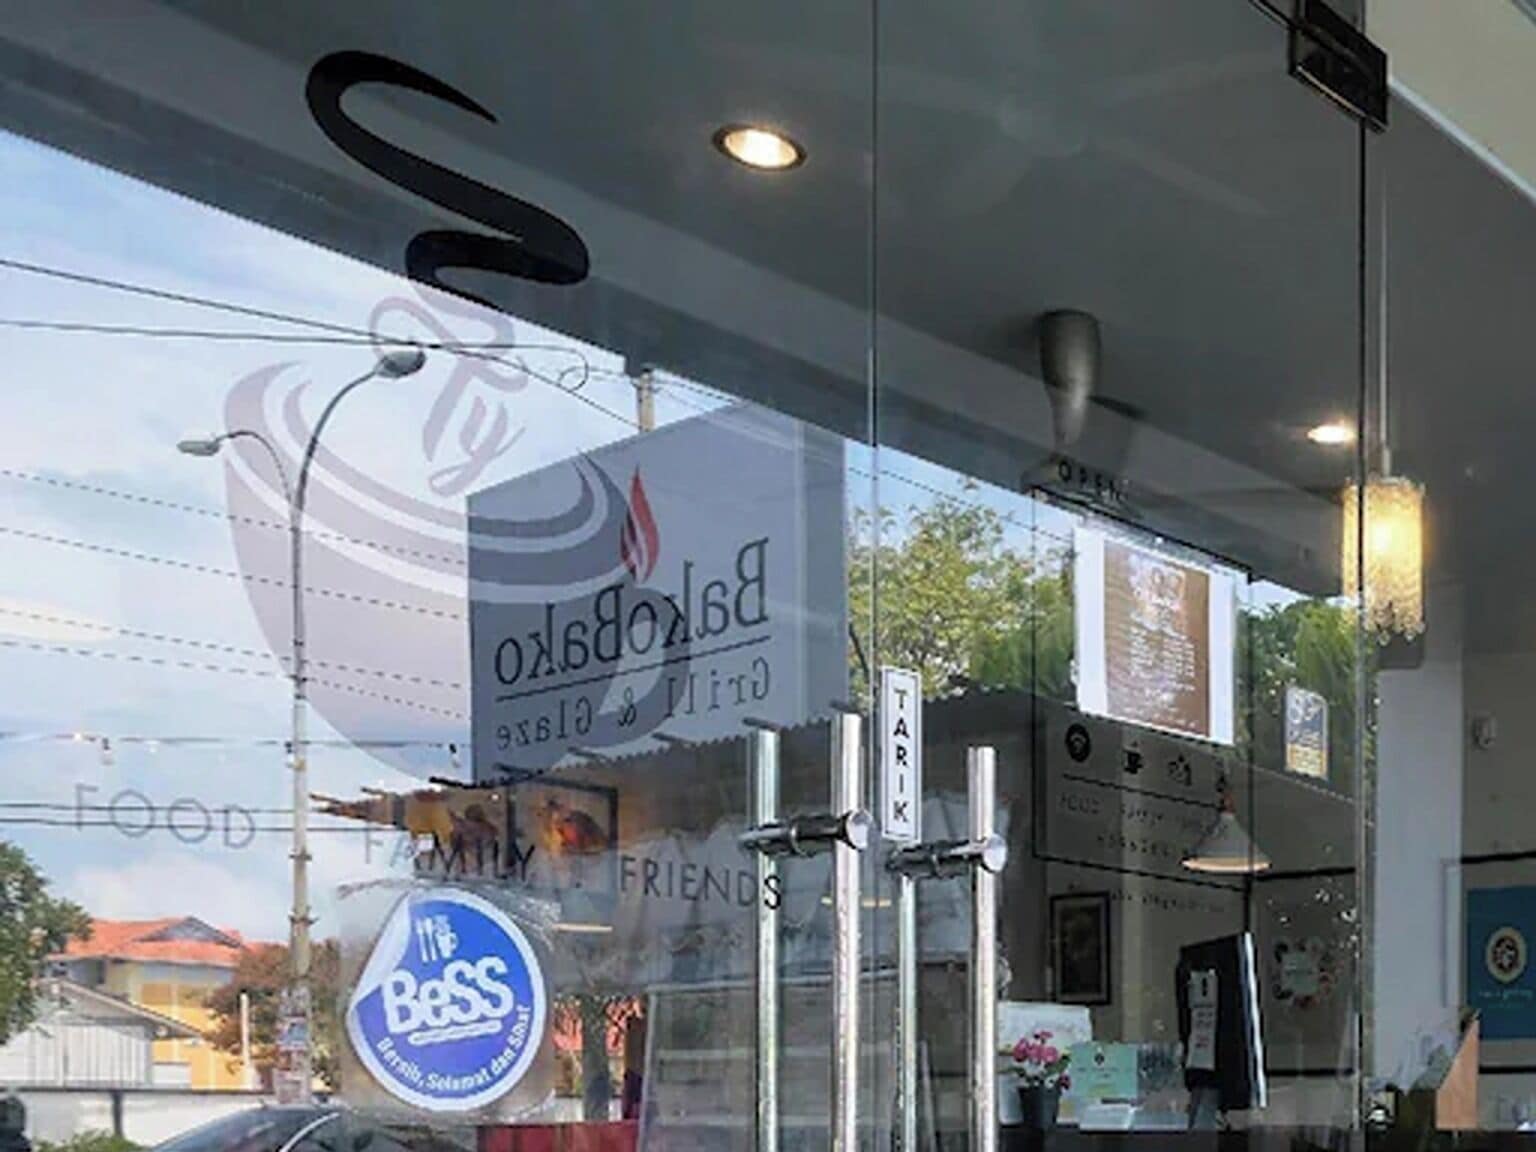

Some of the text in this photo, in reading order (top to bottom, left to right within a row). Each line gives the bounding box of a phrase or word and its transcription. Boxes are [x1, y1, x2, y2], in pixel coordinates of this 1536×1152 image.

[893, 687, 910, 823] TARIK
[74, 783, 255, 848] FOOD
[620, 854, 782, 910] FRIENDS
[382, 955, 514, 1033] BeSS
